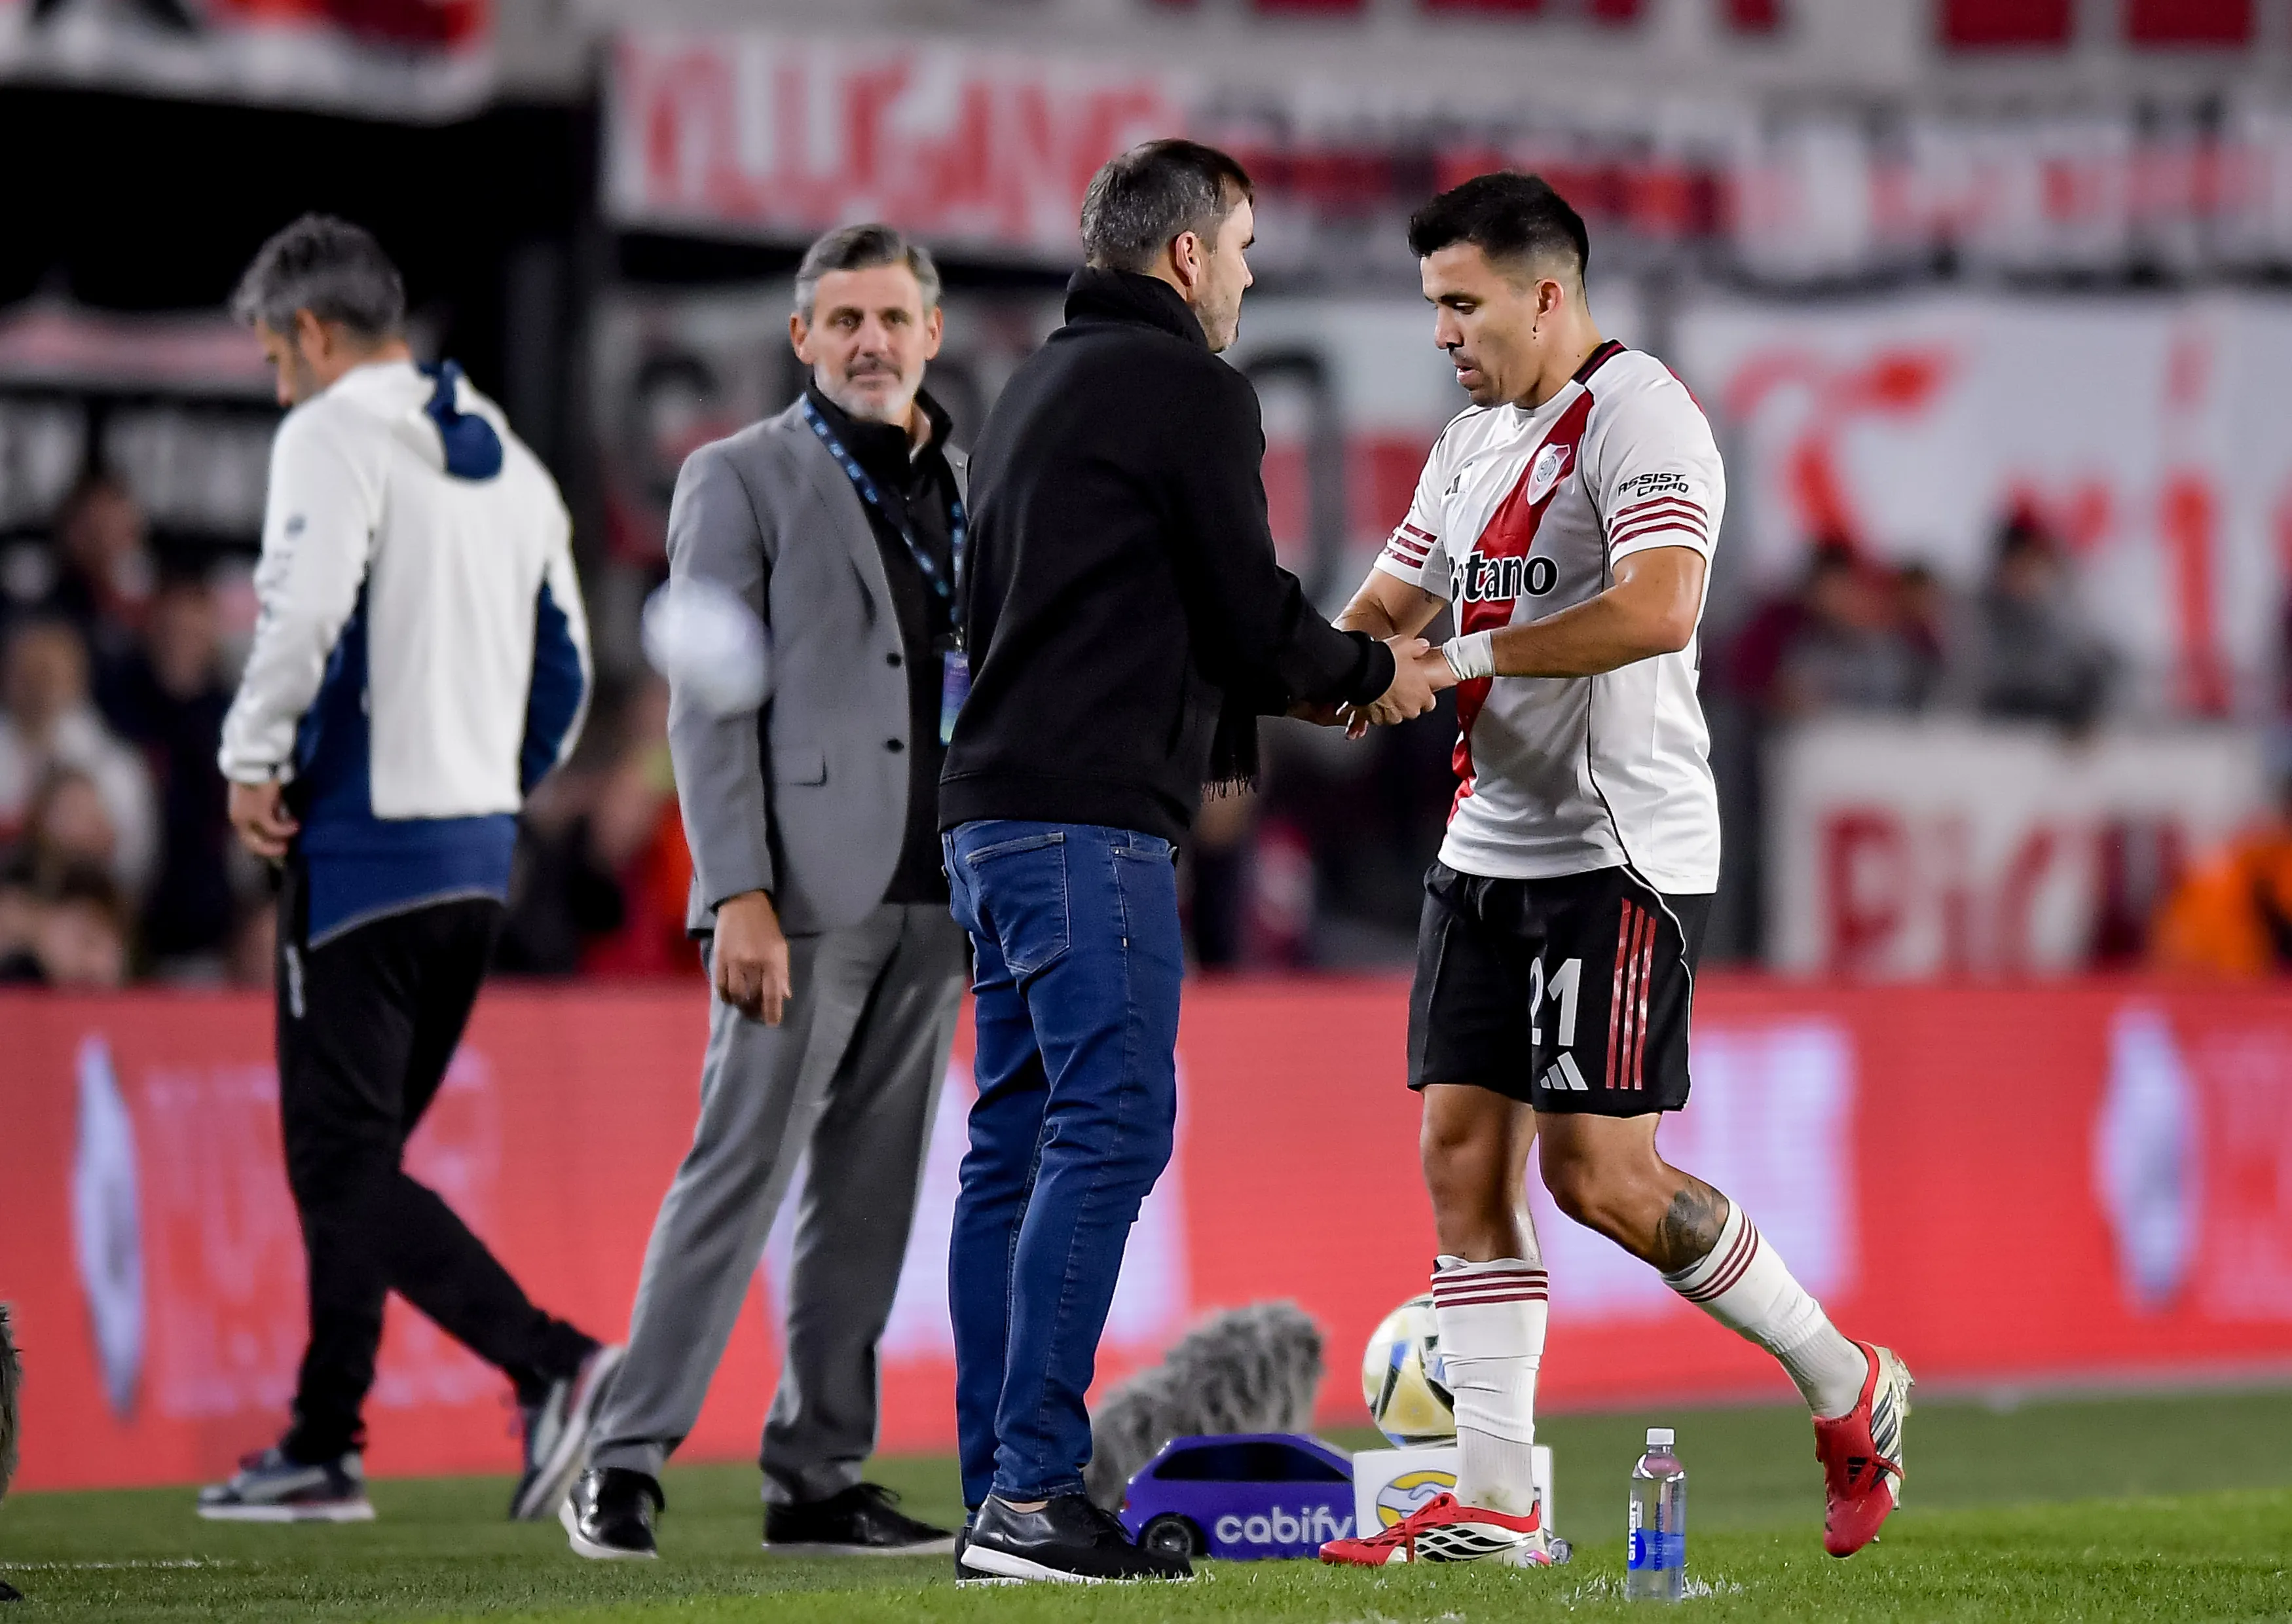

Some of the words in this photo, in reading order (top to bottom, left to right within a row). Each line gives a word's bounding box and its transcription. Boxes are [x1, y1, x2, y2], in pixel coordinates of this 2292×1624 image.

[1618, 473, 1686, 496] ASSIST
[1636, 482, 1690, 498] CARD
[1215, 1505, 1354, 1544] cabify
